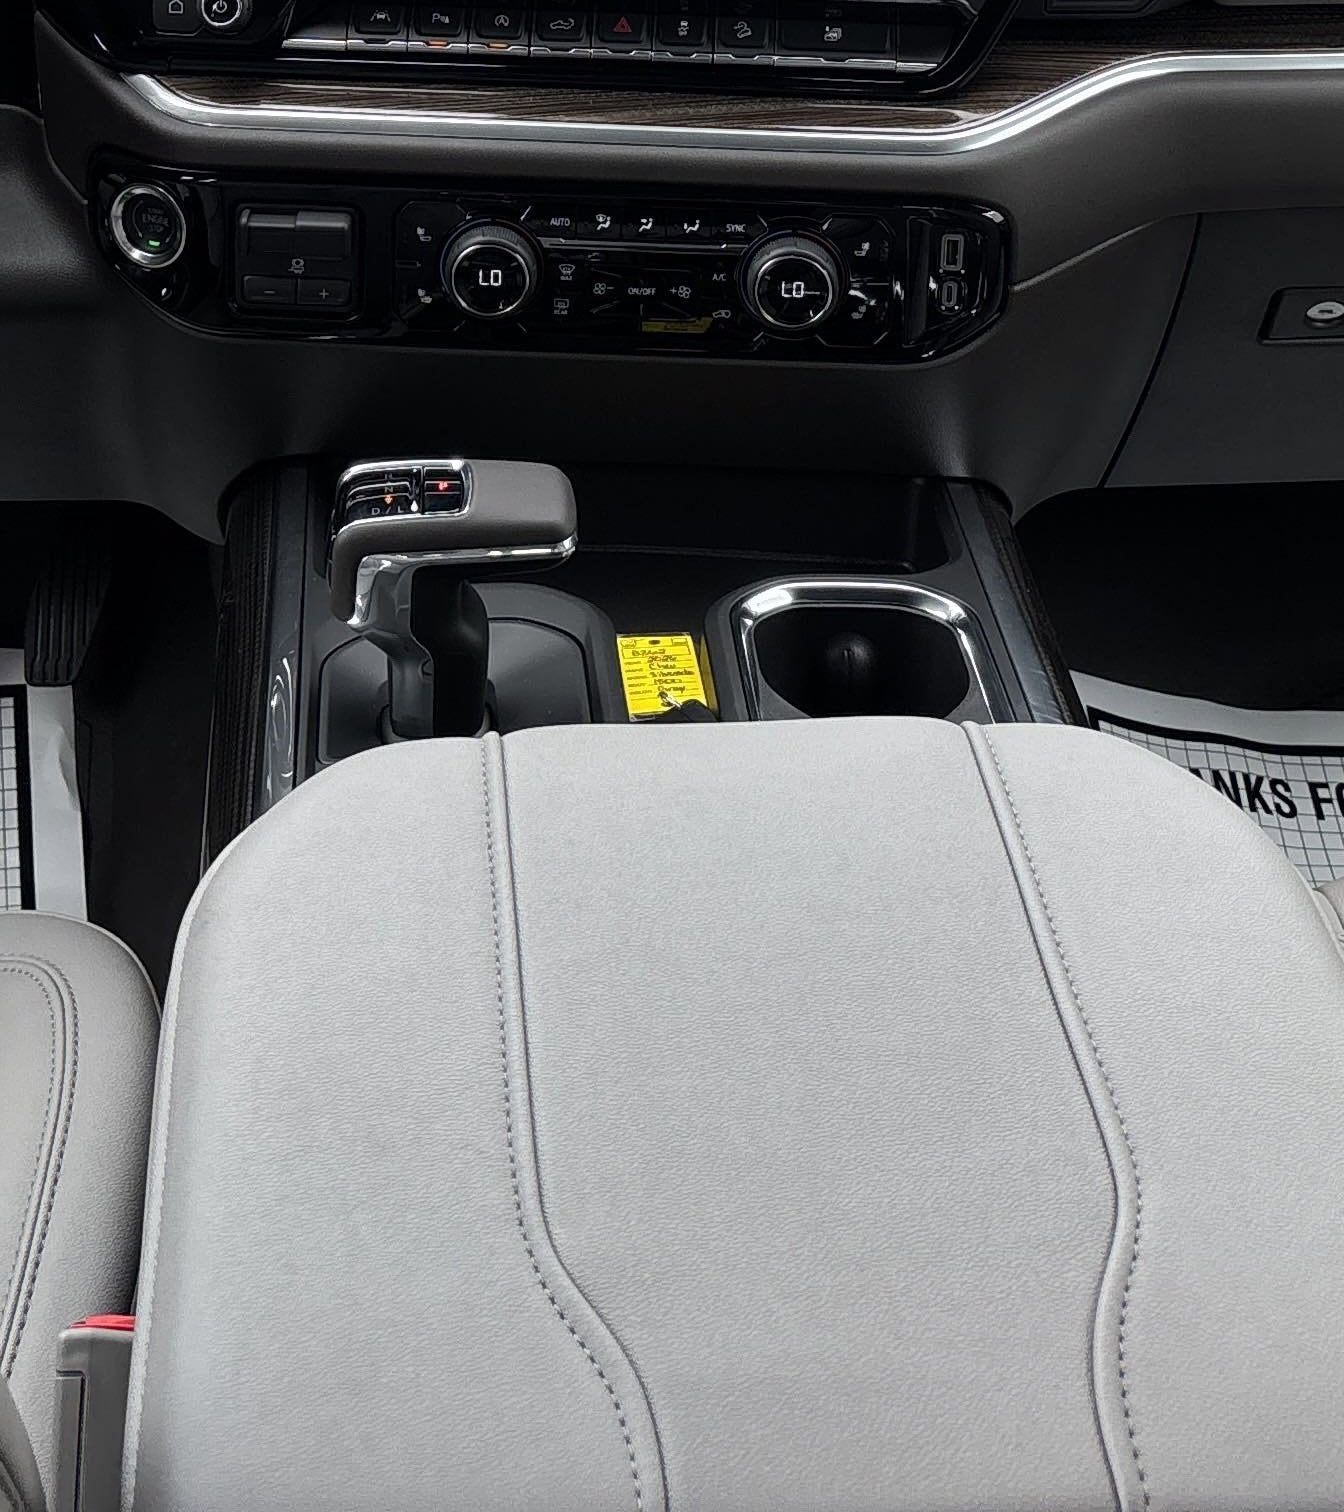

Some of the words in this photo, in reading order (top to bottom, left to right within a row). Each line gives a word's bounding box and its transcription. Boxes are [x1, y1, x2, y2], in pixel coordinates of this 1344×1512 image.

[550, 217, 571, 227] AUTO
[725, 223, 746, 233] SYNC
[478, 269, 502, 287] LO
[712, 272, 727, 282] A/C
[627, 286, 657, 296] ON/OFF
[1189, 768, 1298, 819] NKS
